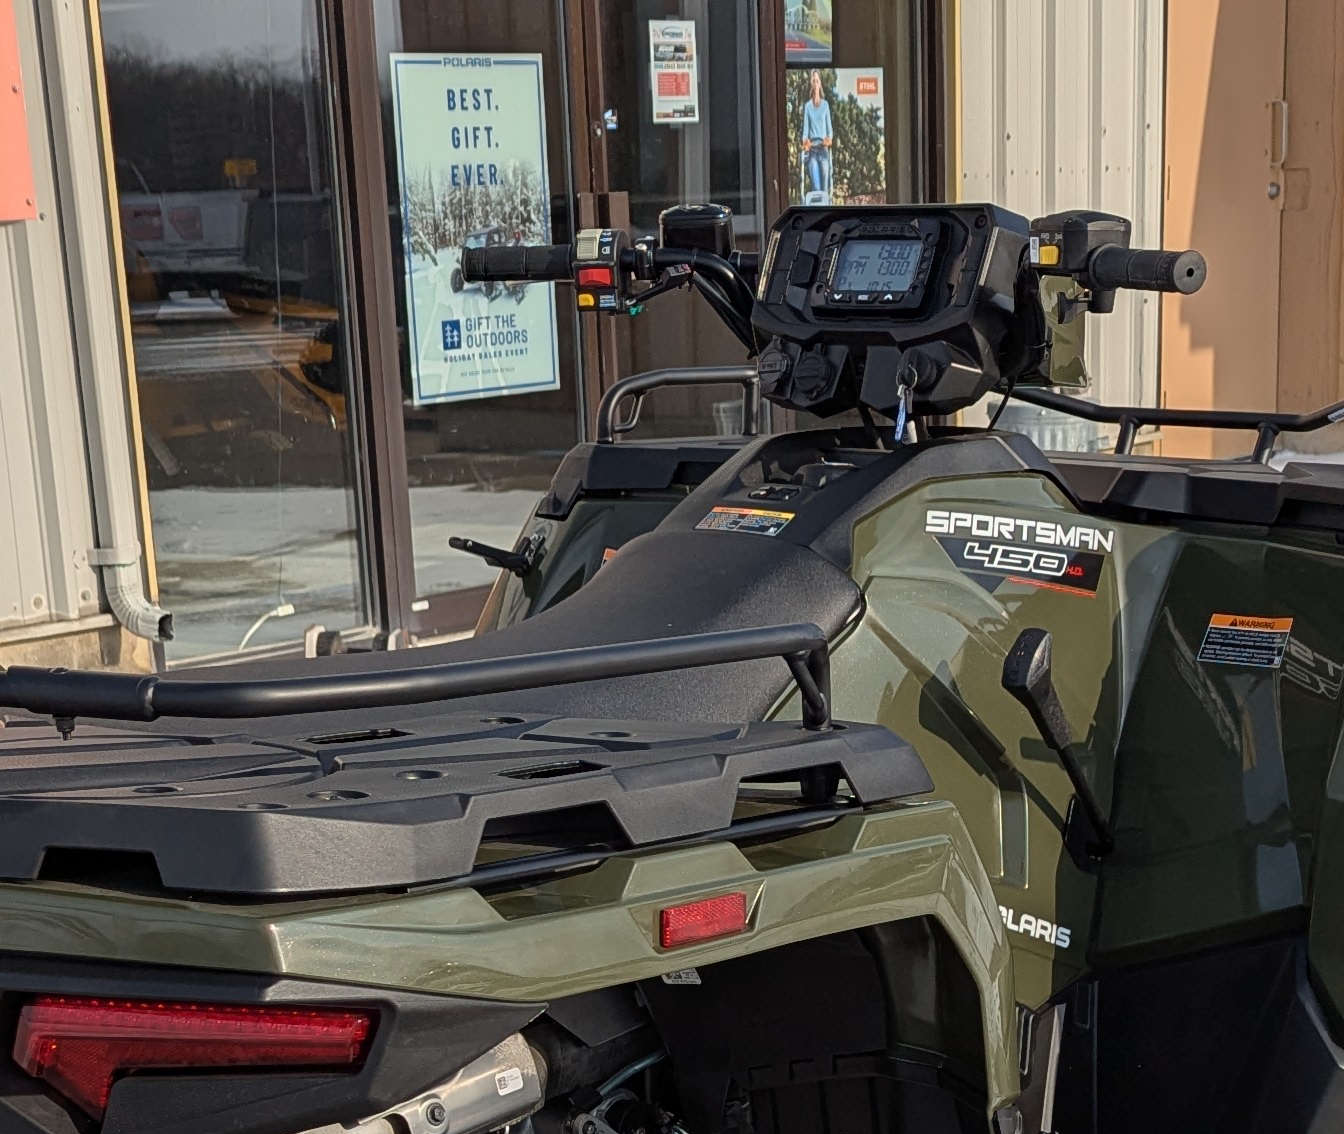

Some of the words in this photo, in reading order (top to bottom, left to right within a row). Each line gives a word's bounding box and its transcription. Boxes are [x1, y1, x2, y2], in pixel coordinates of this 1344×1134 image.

[443, 57, 492, 67] POLARIS
[447, 88, 499, 111] BEST.
[452, 126, 499, 149] GIFT.
[451, 163, 504, 187] EVER.
[466, 316, 491, 332] GIFT
[494, 314, 517, 329] THE
[466, 329, 528, 349] OUTDOORS
[925, 510, 1115, 553] SPORTSMAN
[964, 541, 1068, 577] 450
[1238, 619, 1276, 630] WARNING
